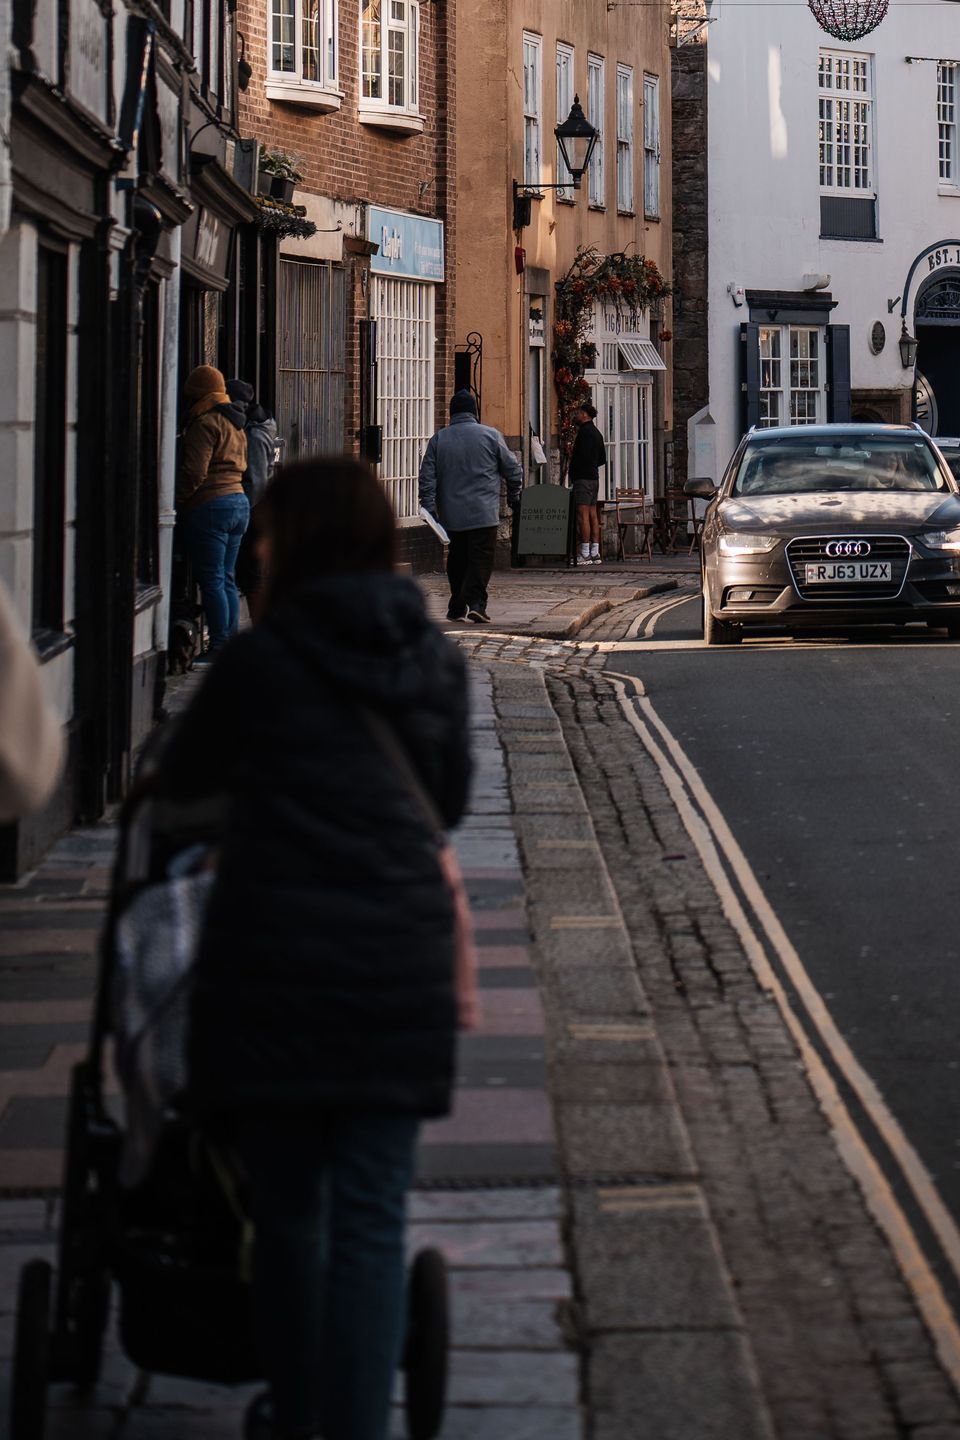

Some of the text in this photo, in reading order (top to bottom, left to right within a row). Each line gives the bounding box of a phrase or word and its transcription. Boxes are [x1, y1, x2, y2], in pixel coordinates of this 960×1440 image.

[927, 249, 954, 272] EST.
[916, 390, 929, 420] GIN
[817, 564, 889, 580] RJ63 UZX
